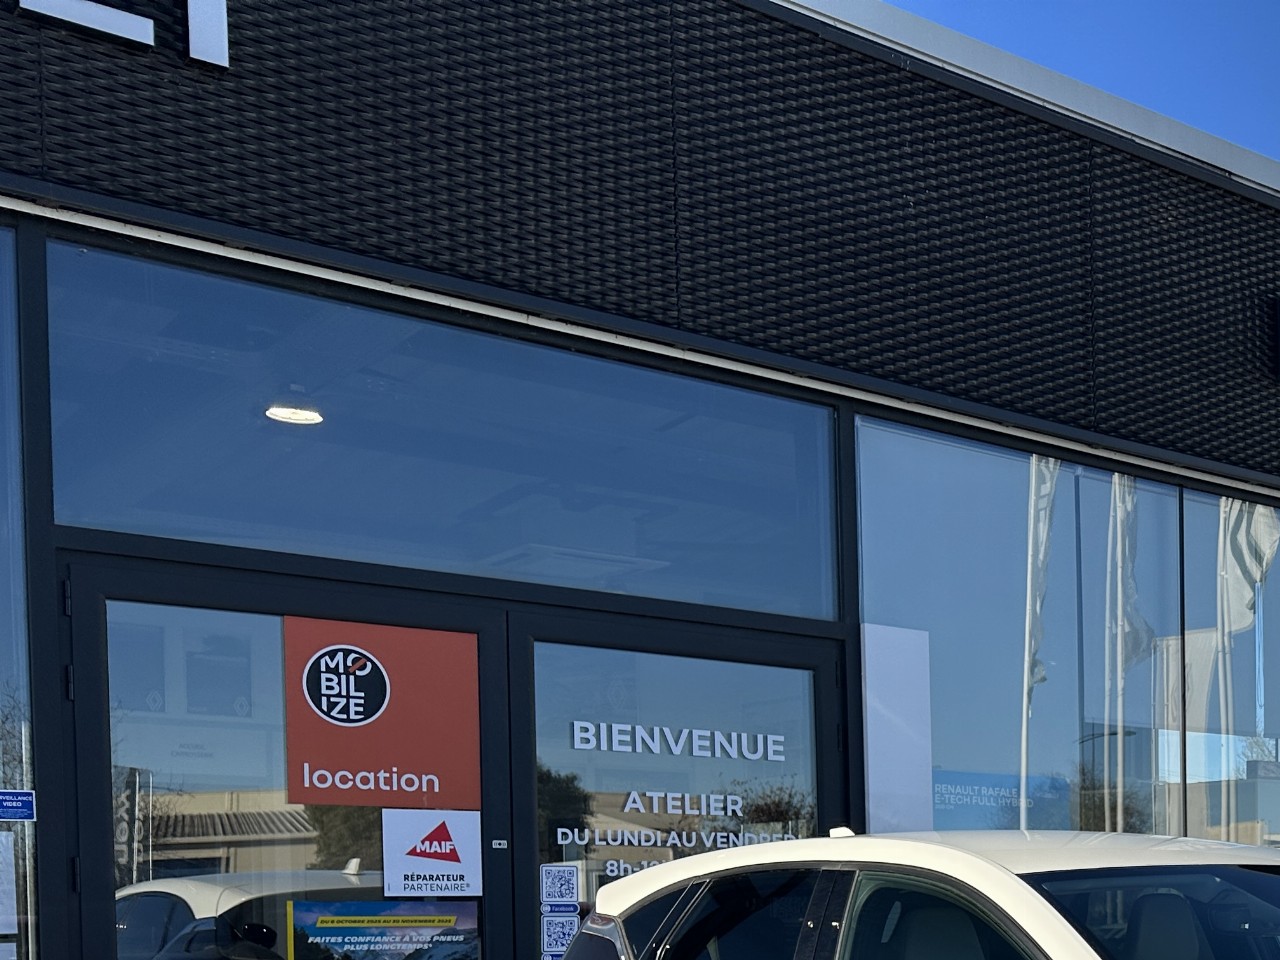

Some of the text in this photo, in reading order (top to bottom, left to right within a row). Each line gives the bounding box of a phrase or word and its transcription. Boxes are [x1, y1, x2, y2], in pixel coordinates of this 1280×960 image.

[321, 673, 365, 697] BIL
[321, 696, 365, 719] IZE
[573, 720, 786, 762] BIENVENUE
[303, 763, 440, 793] location
[935, 784, 1017, 798] RENAULT RAFALE
[623, 790, 744, 817] ATELIER
[935, 794, 971, 805] E-TECH
[972, 795, 997, 806] FULL
[557, 828, 589, 845] DU
[595, 829, 661, 847] LUNDI
[667, 831, 697, 848] AU
[415, 841, 455, 853] MAIF
[403, 872, 465, 882] RÉPARATEUR
[308, 936, 343, 944] FAITES
[344, 935, 401, 943] CONFIANCE
[343, 943, 369, 951] PLUS
